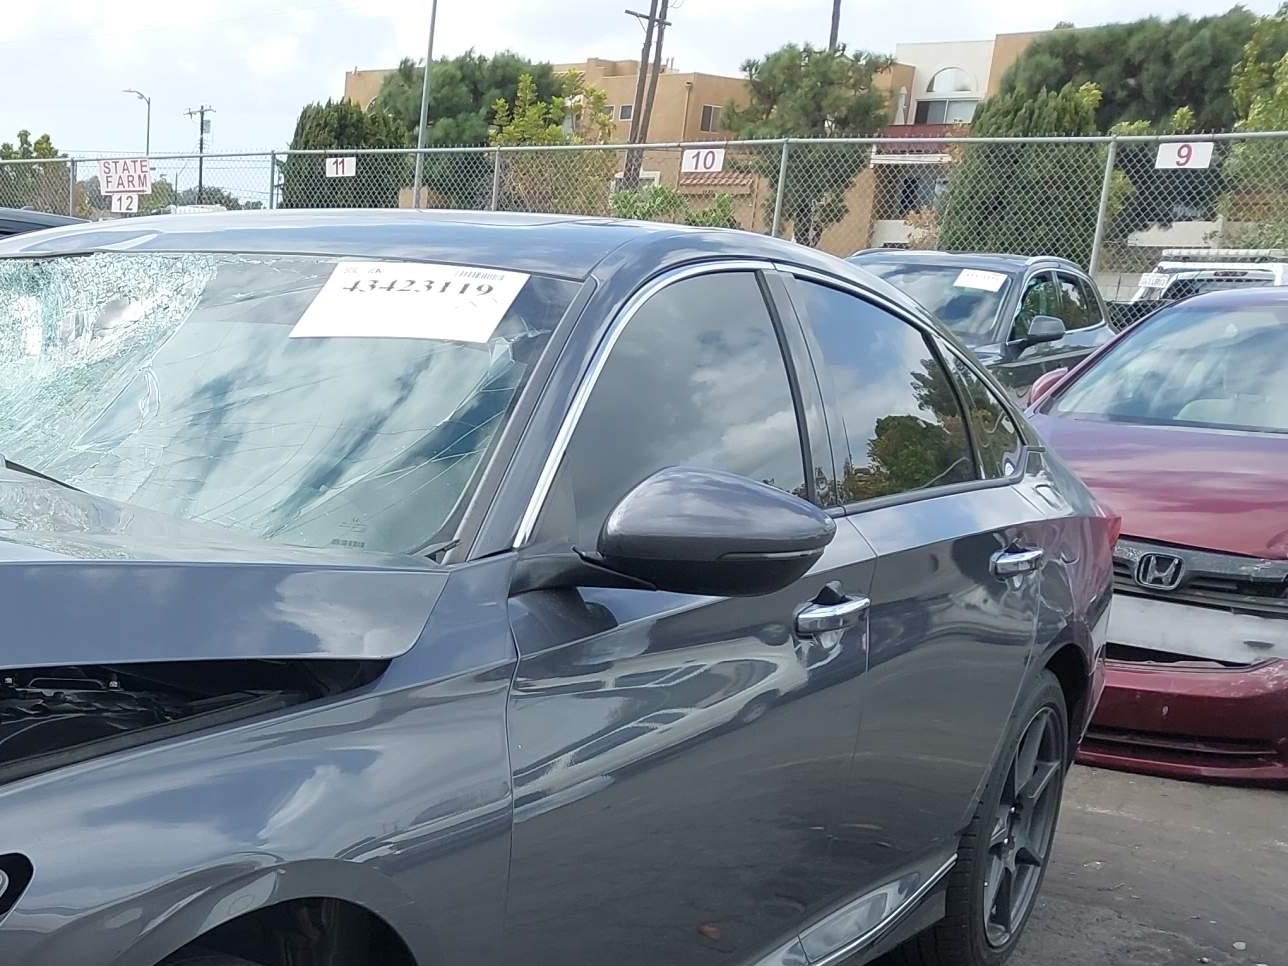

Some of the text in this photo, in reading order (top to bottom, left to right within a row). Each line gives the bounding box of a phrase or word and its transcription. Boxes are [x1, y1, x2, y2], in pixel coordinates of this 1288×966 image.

[692, 150, 716, 170] 10
[1176, 144, 1192, 166] 9
[103, 160, 149, 174] STATE
[332, 158, 345, 175] 11
[105, 174, 148, 188] FARM
[116, 195, 134, 211] 12
[342, 279, 494, 296] 43423119
